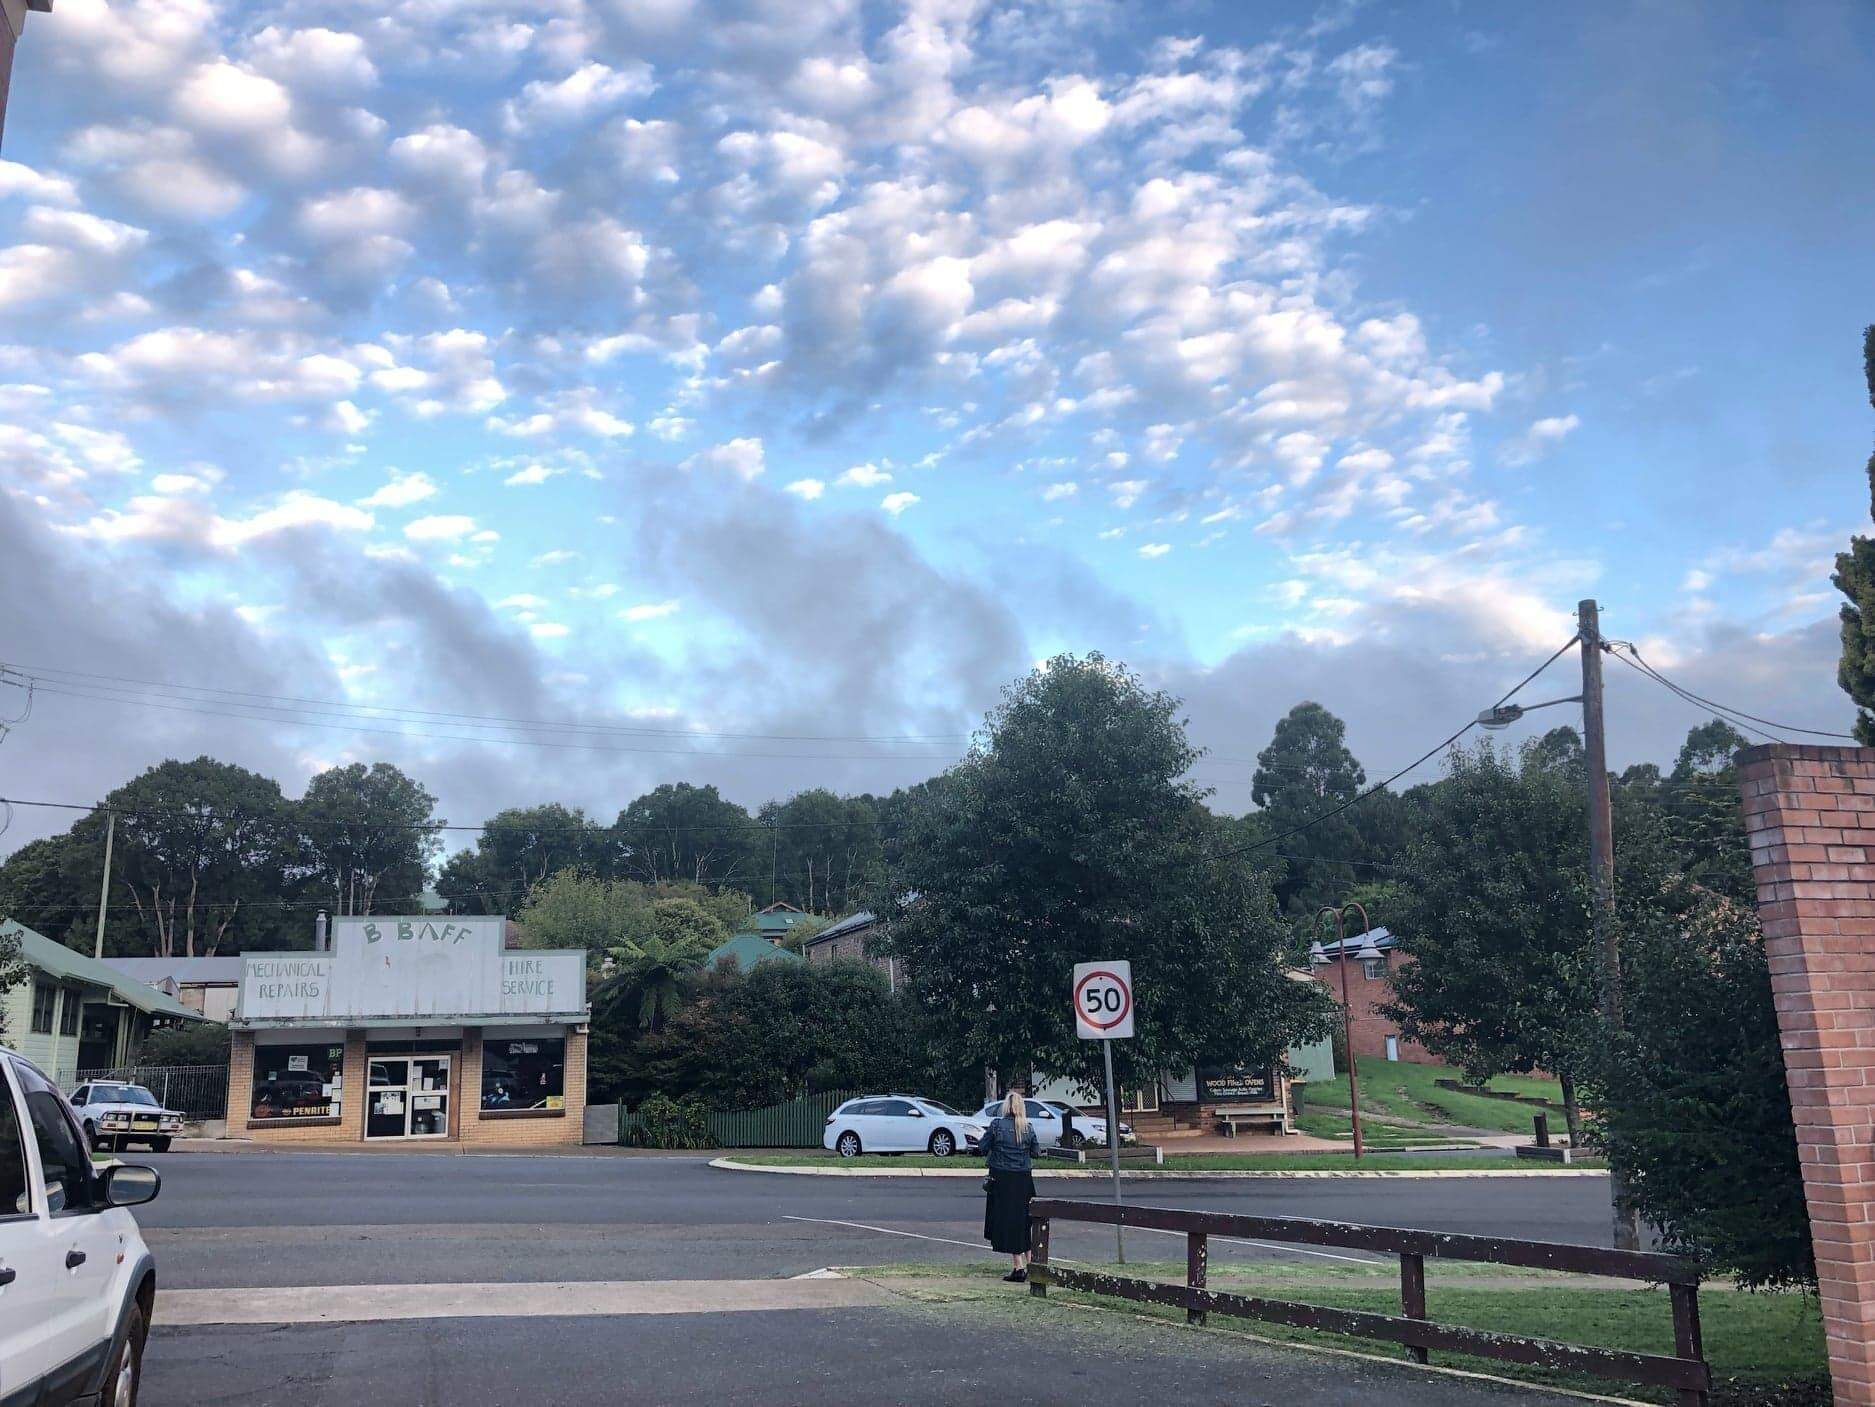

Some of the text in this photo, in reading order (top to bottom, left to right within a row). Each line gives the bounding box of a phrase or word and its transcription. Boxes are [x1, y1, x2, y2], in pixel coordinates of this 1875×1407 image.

[363, 922, 472, 944] B BAFF
[246, 962, 326, 977] MECHANICAL
[508, 960, 543, 975] HIRE
[259, 982, 320, 999] REPAIRS
[502, 980, 554, 996] SERVICE
[1086, 987, 1121, 1014] 50
[328, 1048, 343, 1058] BP
[292, 1106, 332, 1116] PENRITE
